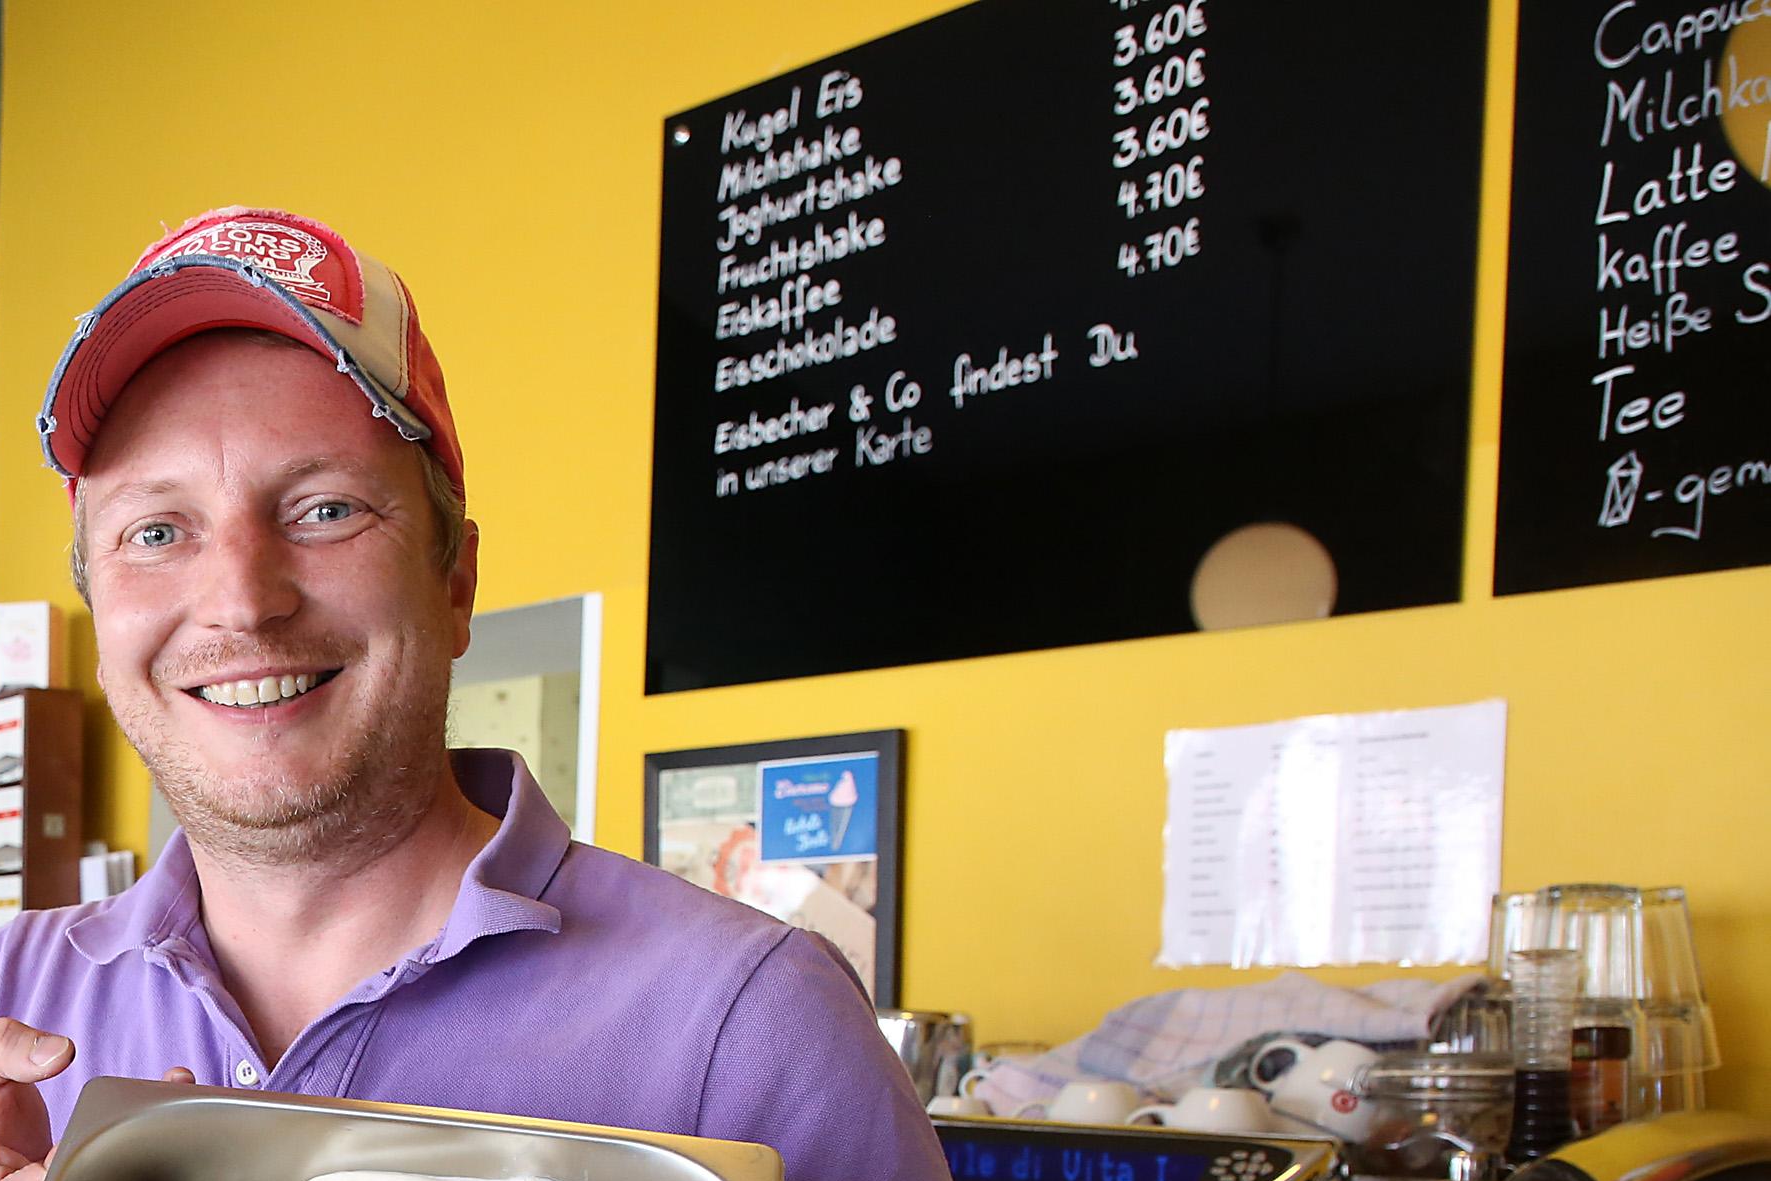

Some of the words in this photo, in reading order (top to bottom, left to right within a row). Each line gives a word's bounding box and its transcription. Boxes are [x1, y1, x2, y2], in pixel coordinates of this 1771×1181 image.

[1113, 0, 1208, 67] 3.60€
[720, 86, 802, 155] Kugel
[816, 69, 863, 119] Eis
[1113, 47, 1207, 115] 3.60€
[717, 124, 863, 203] Milchshake
[1112, 97, 1212, 168] 3.60€
[716, 154, 904, 252] Joghurtshake
[1117, 155, 1206, 220] 4.70€
[1594, 142, 1738, 225] Latte
[717, 210, 887, 295] Fruchtshake
[1117, 217, 1202, 278] 4.70€
[715, 273, 844, 340] Eiskaffee
[1598, 291, 1713, 359] Heiße
[714, 396, 836, 454] Eisbecher
[848, 384, 874, 422] &
[885, 369, 922, 413] Co
[948, 332, 1060, 409] findest
[1086, 323, 1139, 368] Du
[1590, 364, 1686, 442] Tee
[715, 467, 739, 498] in
[744, 447, 840, 491] unserer
[854, 415, 934, 467] Karte
